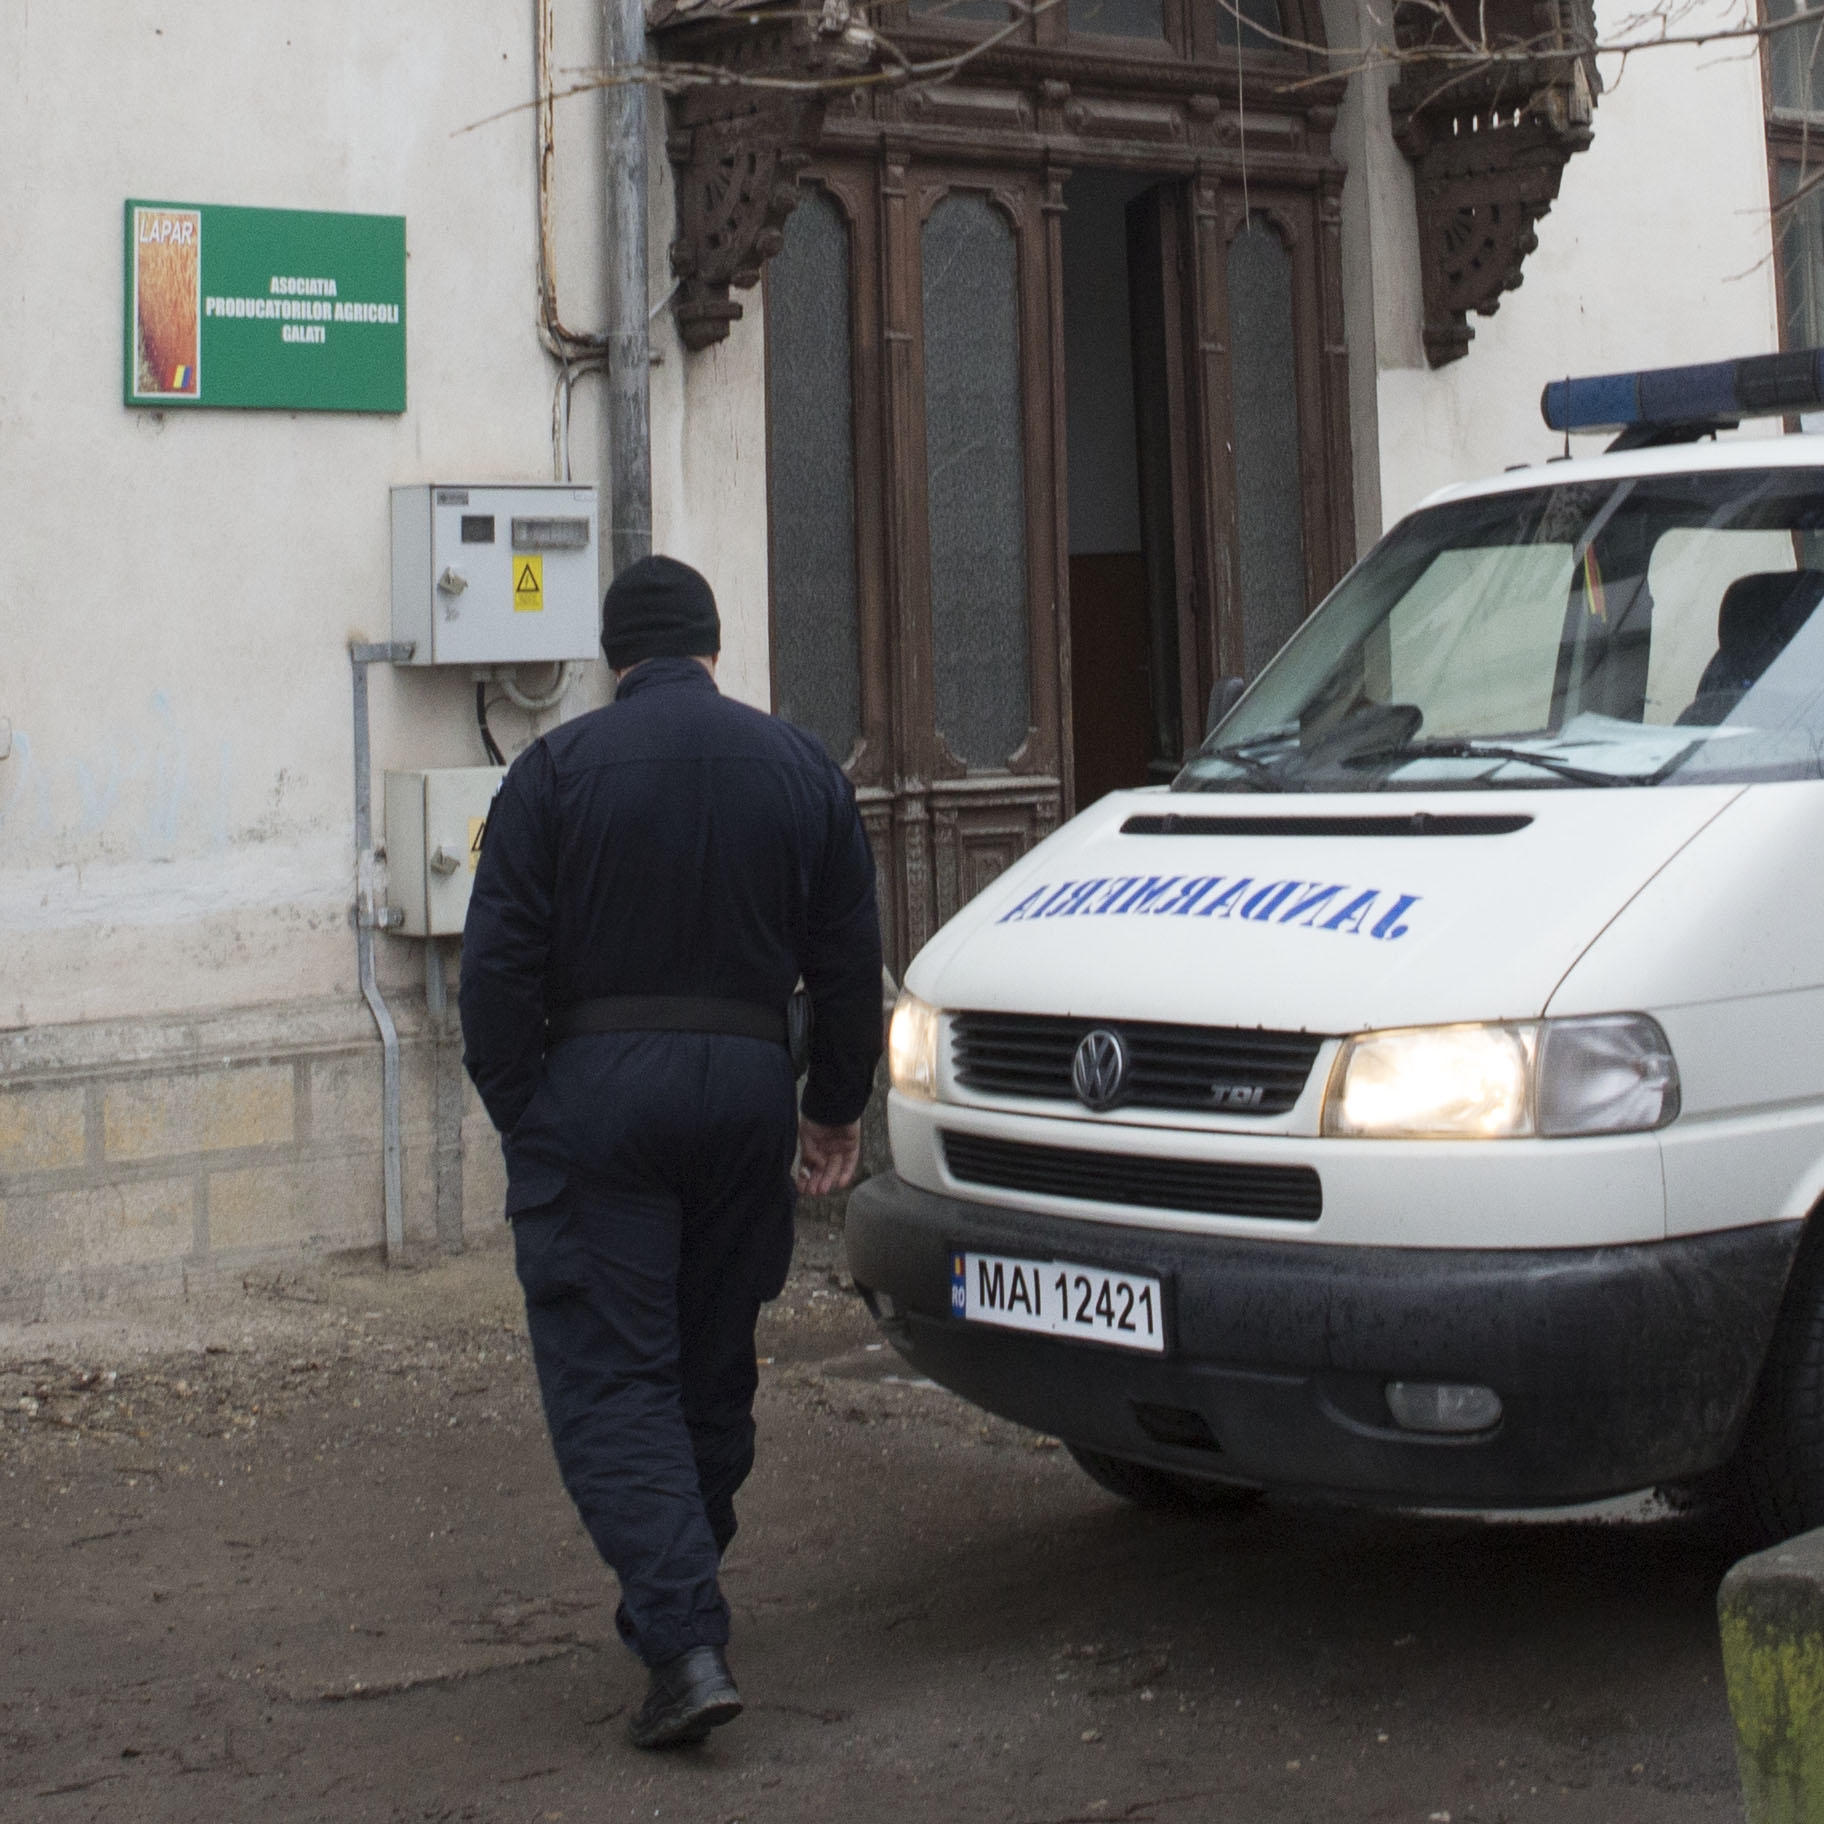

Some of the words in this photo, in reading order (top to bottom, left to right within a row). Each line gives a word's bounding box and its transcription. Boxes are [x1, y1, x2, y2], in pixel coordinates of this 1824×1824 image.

[140, 219, 193, 245] LAPAR
[270, 276, 337, 297] ASOCIATIA
[206, 297, 332, 321] PRODUCATORILOR
[334, 303, 399, 323] AGRICOLI
[282, 325, 325, 343] GALATI
[1211, 1084, 1264, 1107] TDI
[951, 1285, 965, 1307] RO
[978, 1259, 1042, 1316] MAI
[1055, 1271, 1154, 1335] 12421
